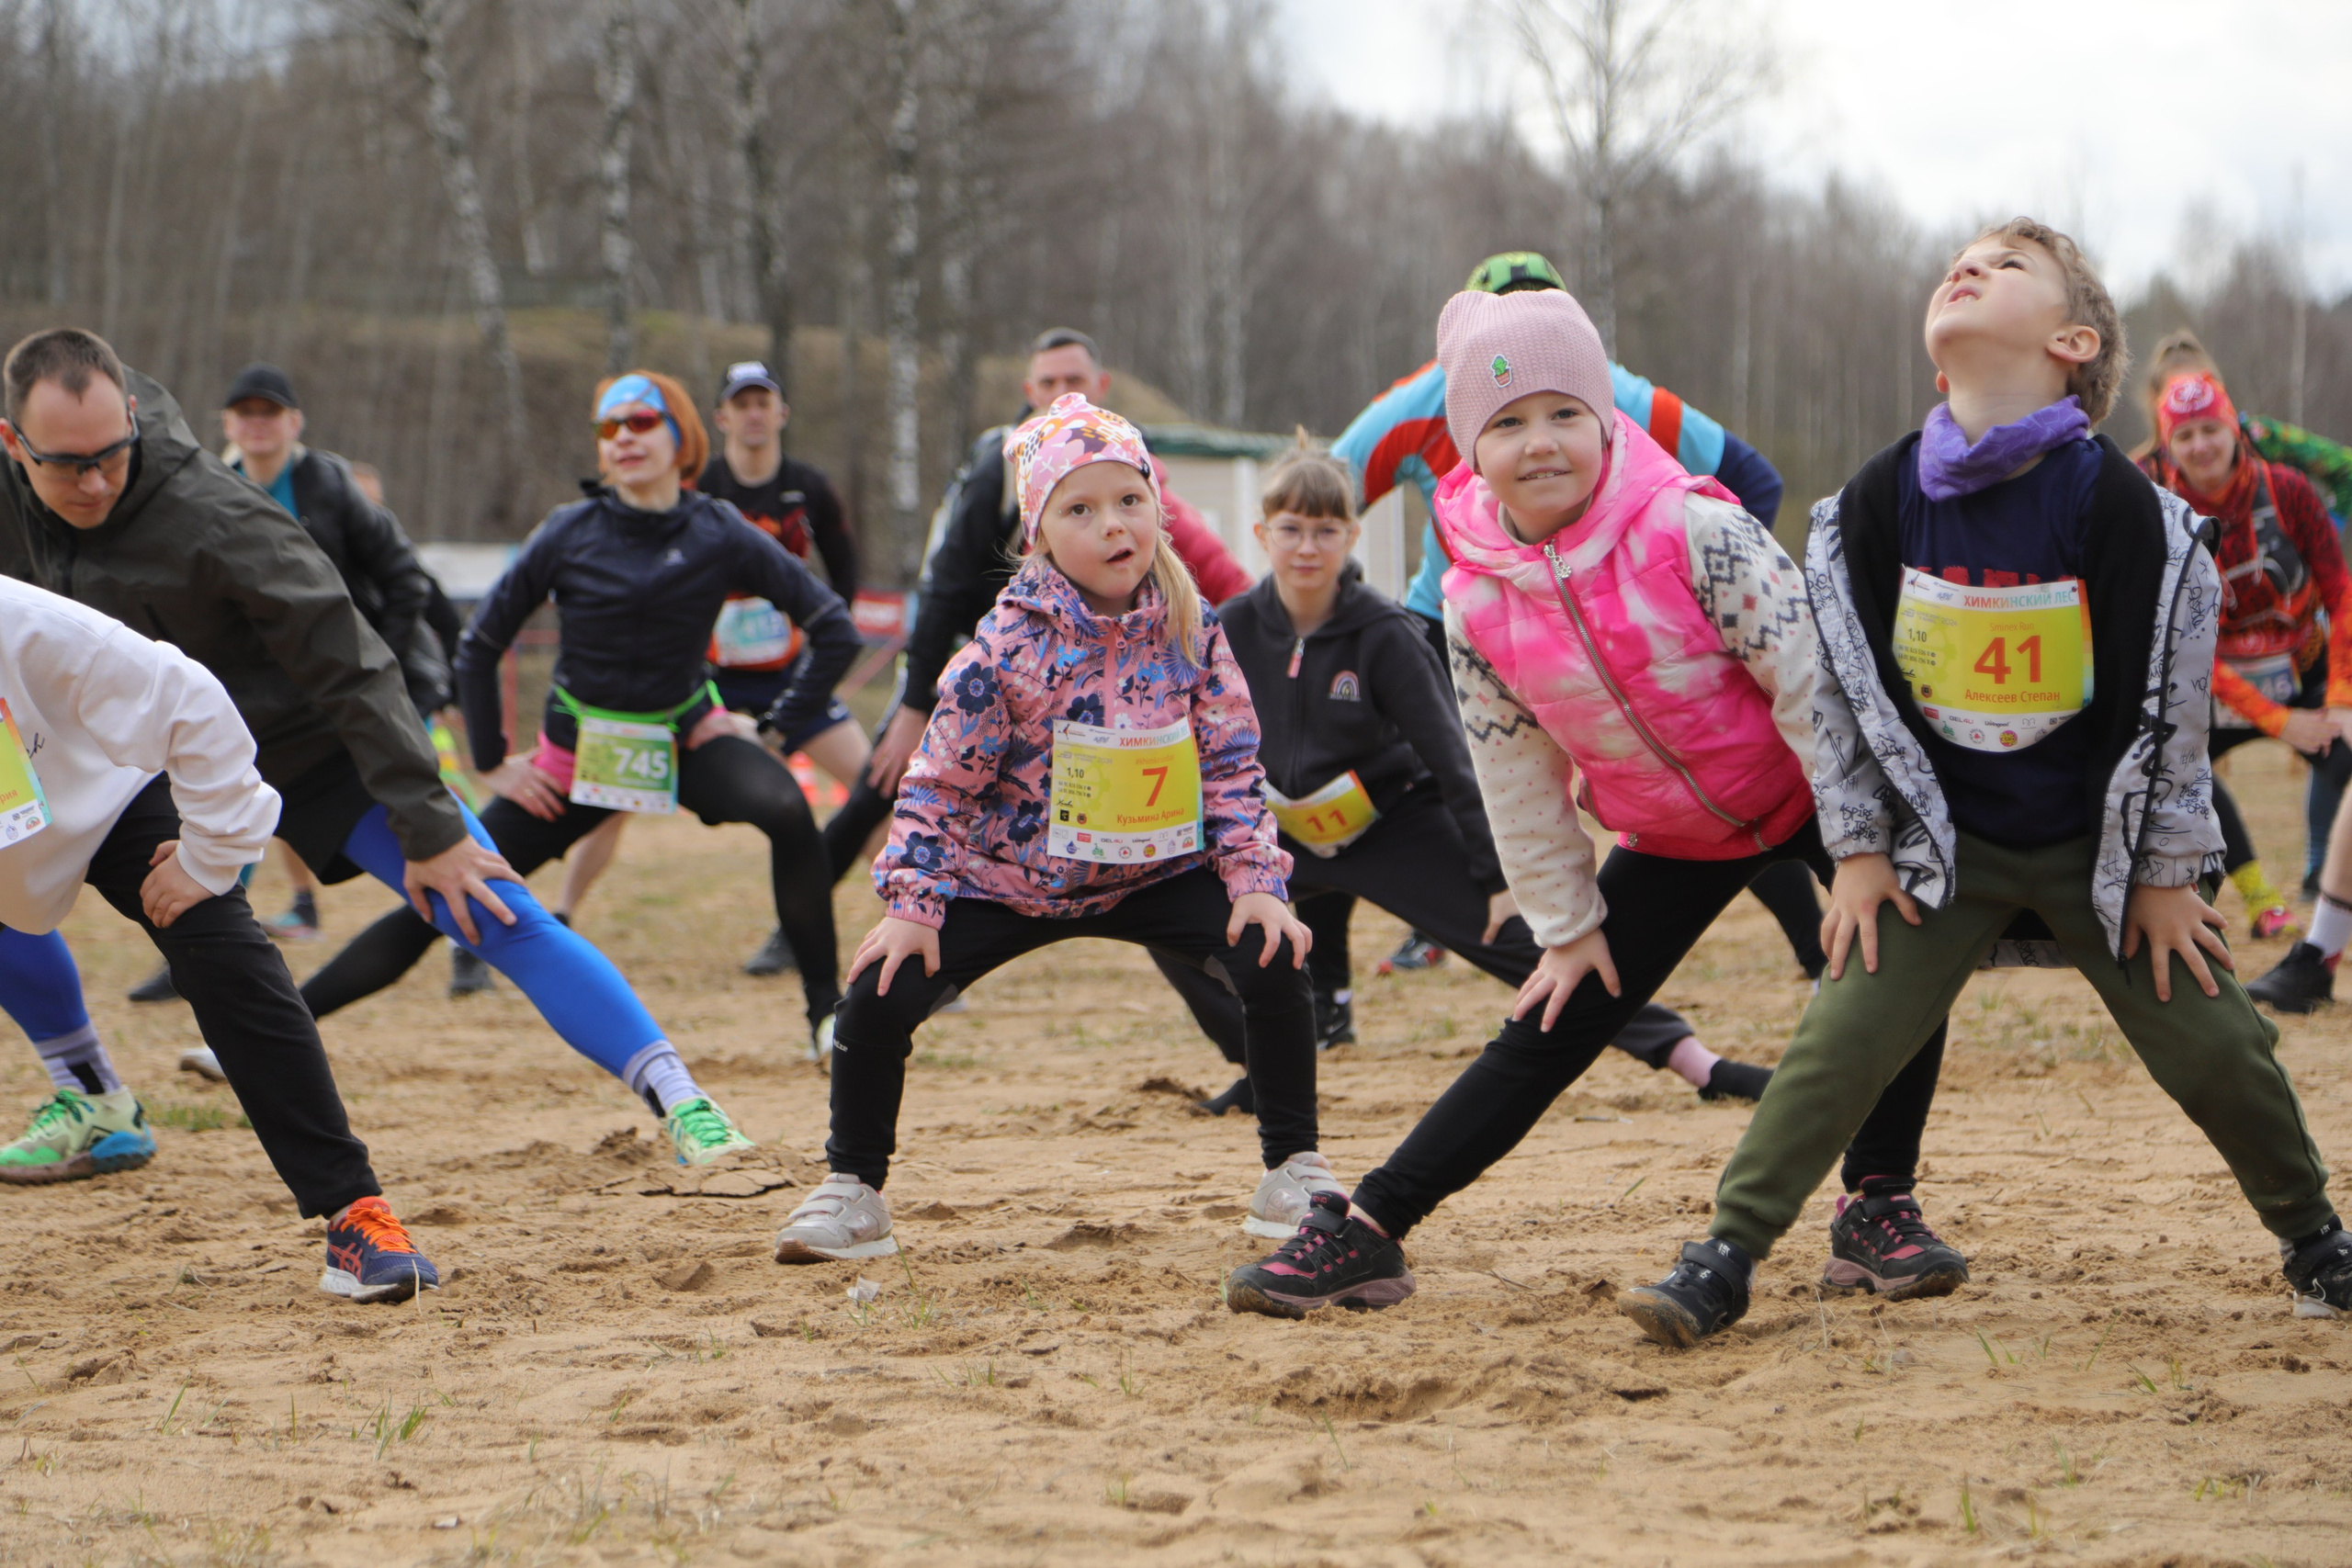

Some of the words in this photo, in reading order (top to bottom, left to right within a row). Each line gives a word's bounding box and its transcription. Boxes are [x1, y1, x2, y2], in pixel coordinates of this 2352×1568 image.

[1963, 591, 2051, 608] ХИМКИНСКИЙ
[2054, 591, 2075, 604] ЛЕС
[1990, 622, 2018, 633] Sminex
[2019, 622, 2035, 631] Run
[1973, 635, 2041, 684] 41
[1964, 689, 2018, 704] Алексеев
[2019, 690, 2061, 703] Степан
[1119, 728, 1180, 748] ХИМКИНСКИЙ
[613, 747, 669, 779] 745
[1067, 767, 1084, 779] 1,10
[1142, 766, 1169, 807] 7
[1116, 813, 1159, 827] Кузьмина
[1160, 808, 1185, 822] Арина
[1306, 809, 1348, 833] 11
